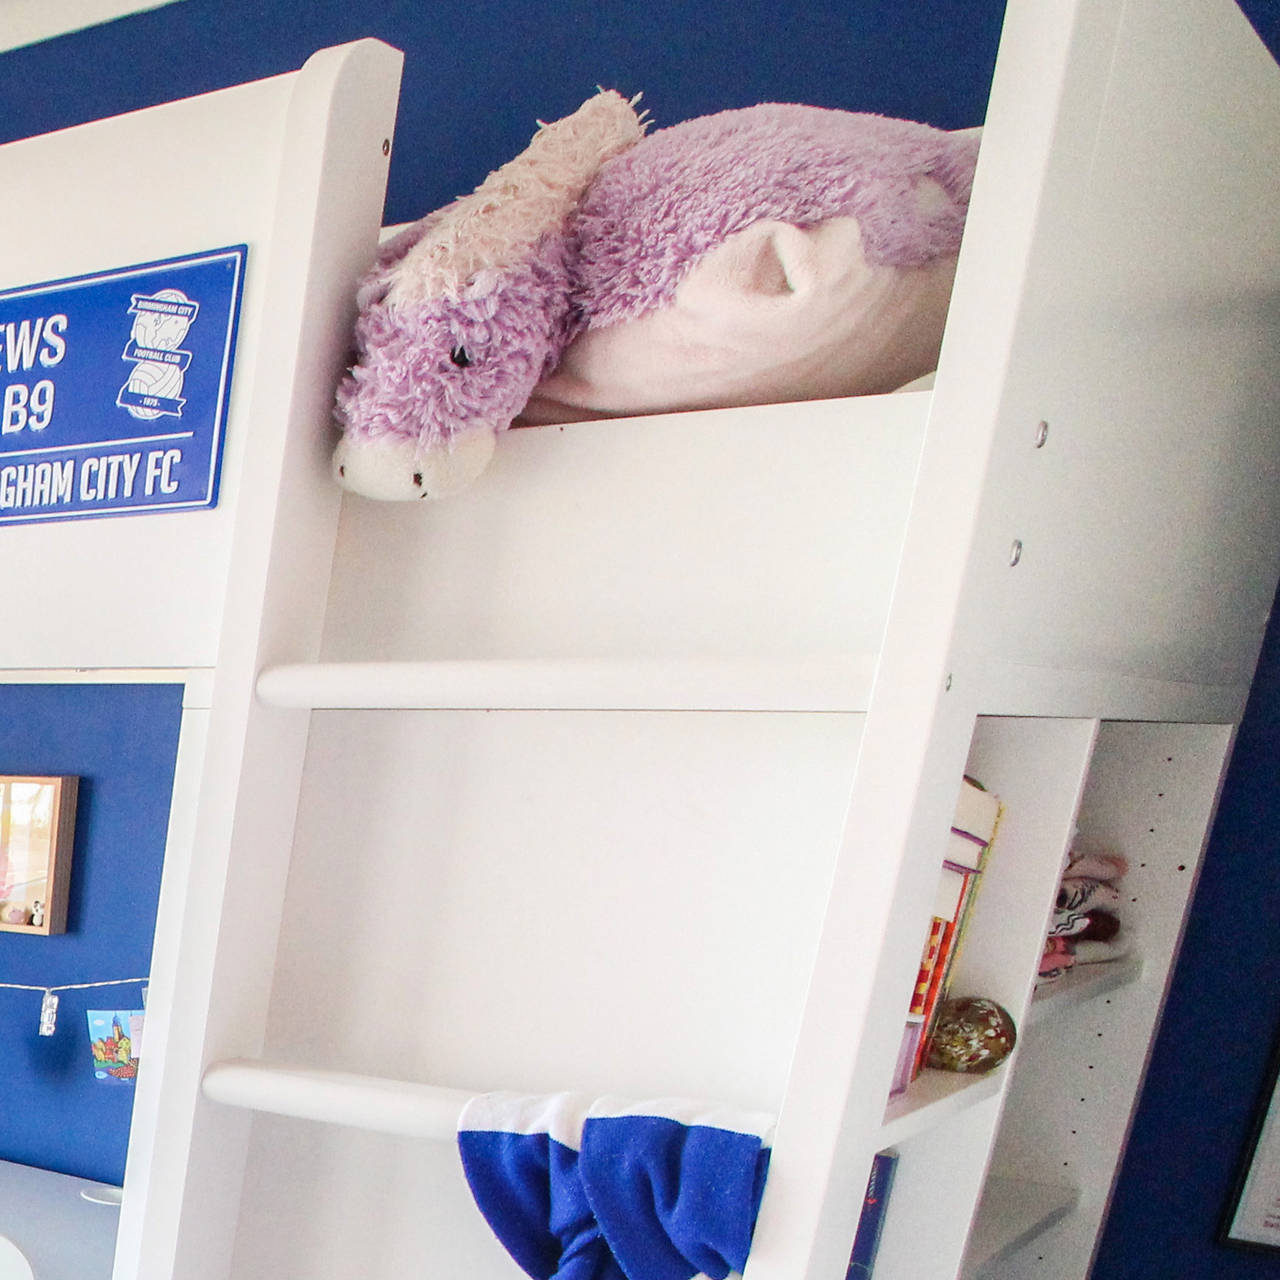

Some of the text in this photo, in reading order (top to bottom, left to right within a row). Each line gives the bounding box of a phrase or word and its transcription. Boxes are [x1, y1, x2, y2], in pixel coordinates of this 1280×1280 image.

[134, 348, 182, 364] FOOTBALL CLUB
[1, 379, 54, 437] B9
[80, 453, 142, 502] CITY
[143, 448, 182, 497] FC
